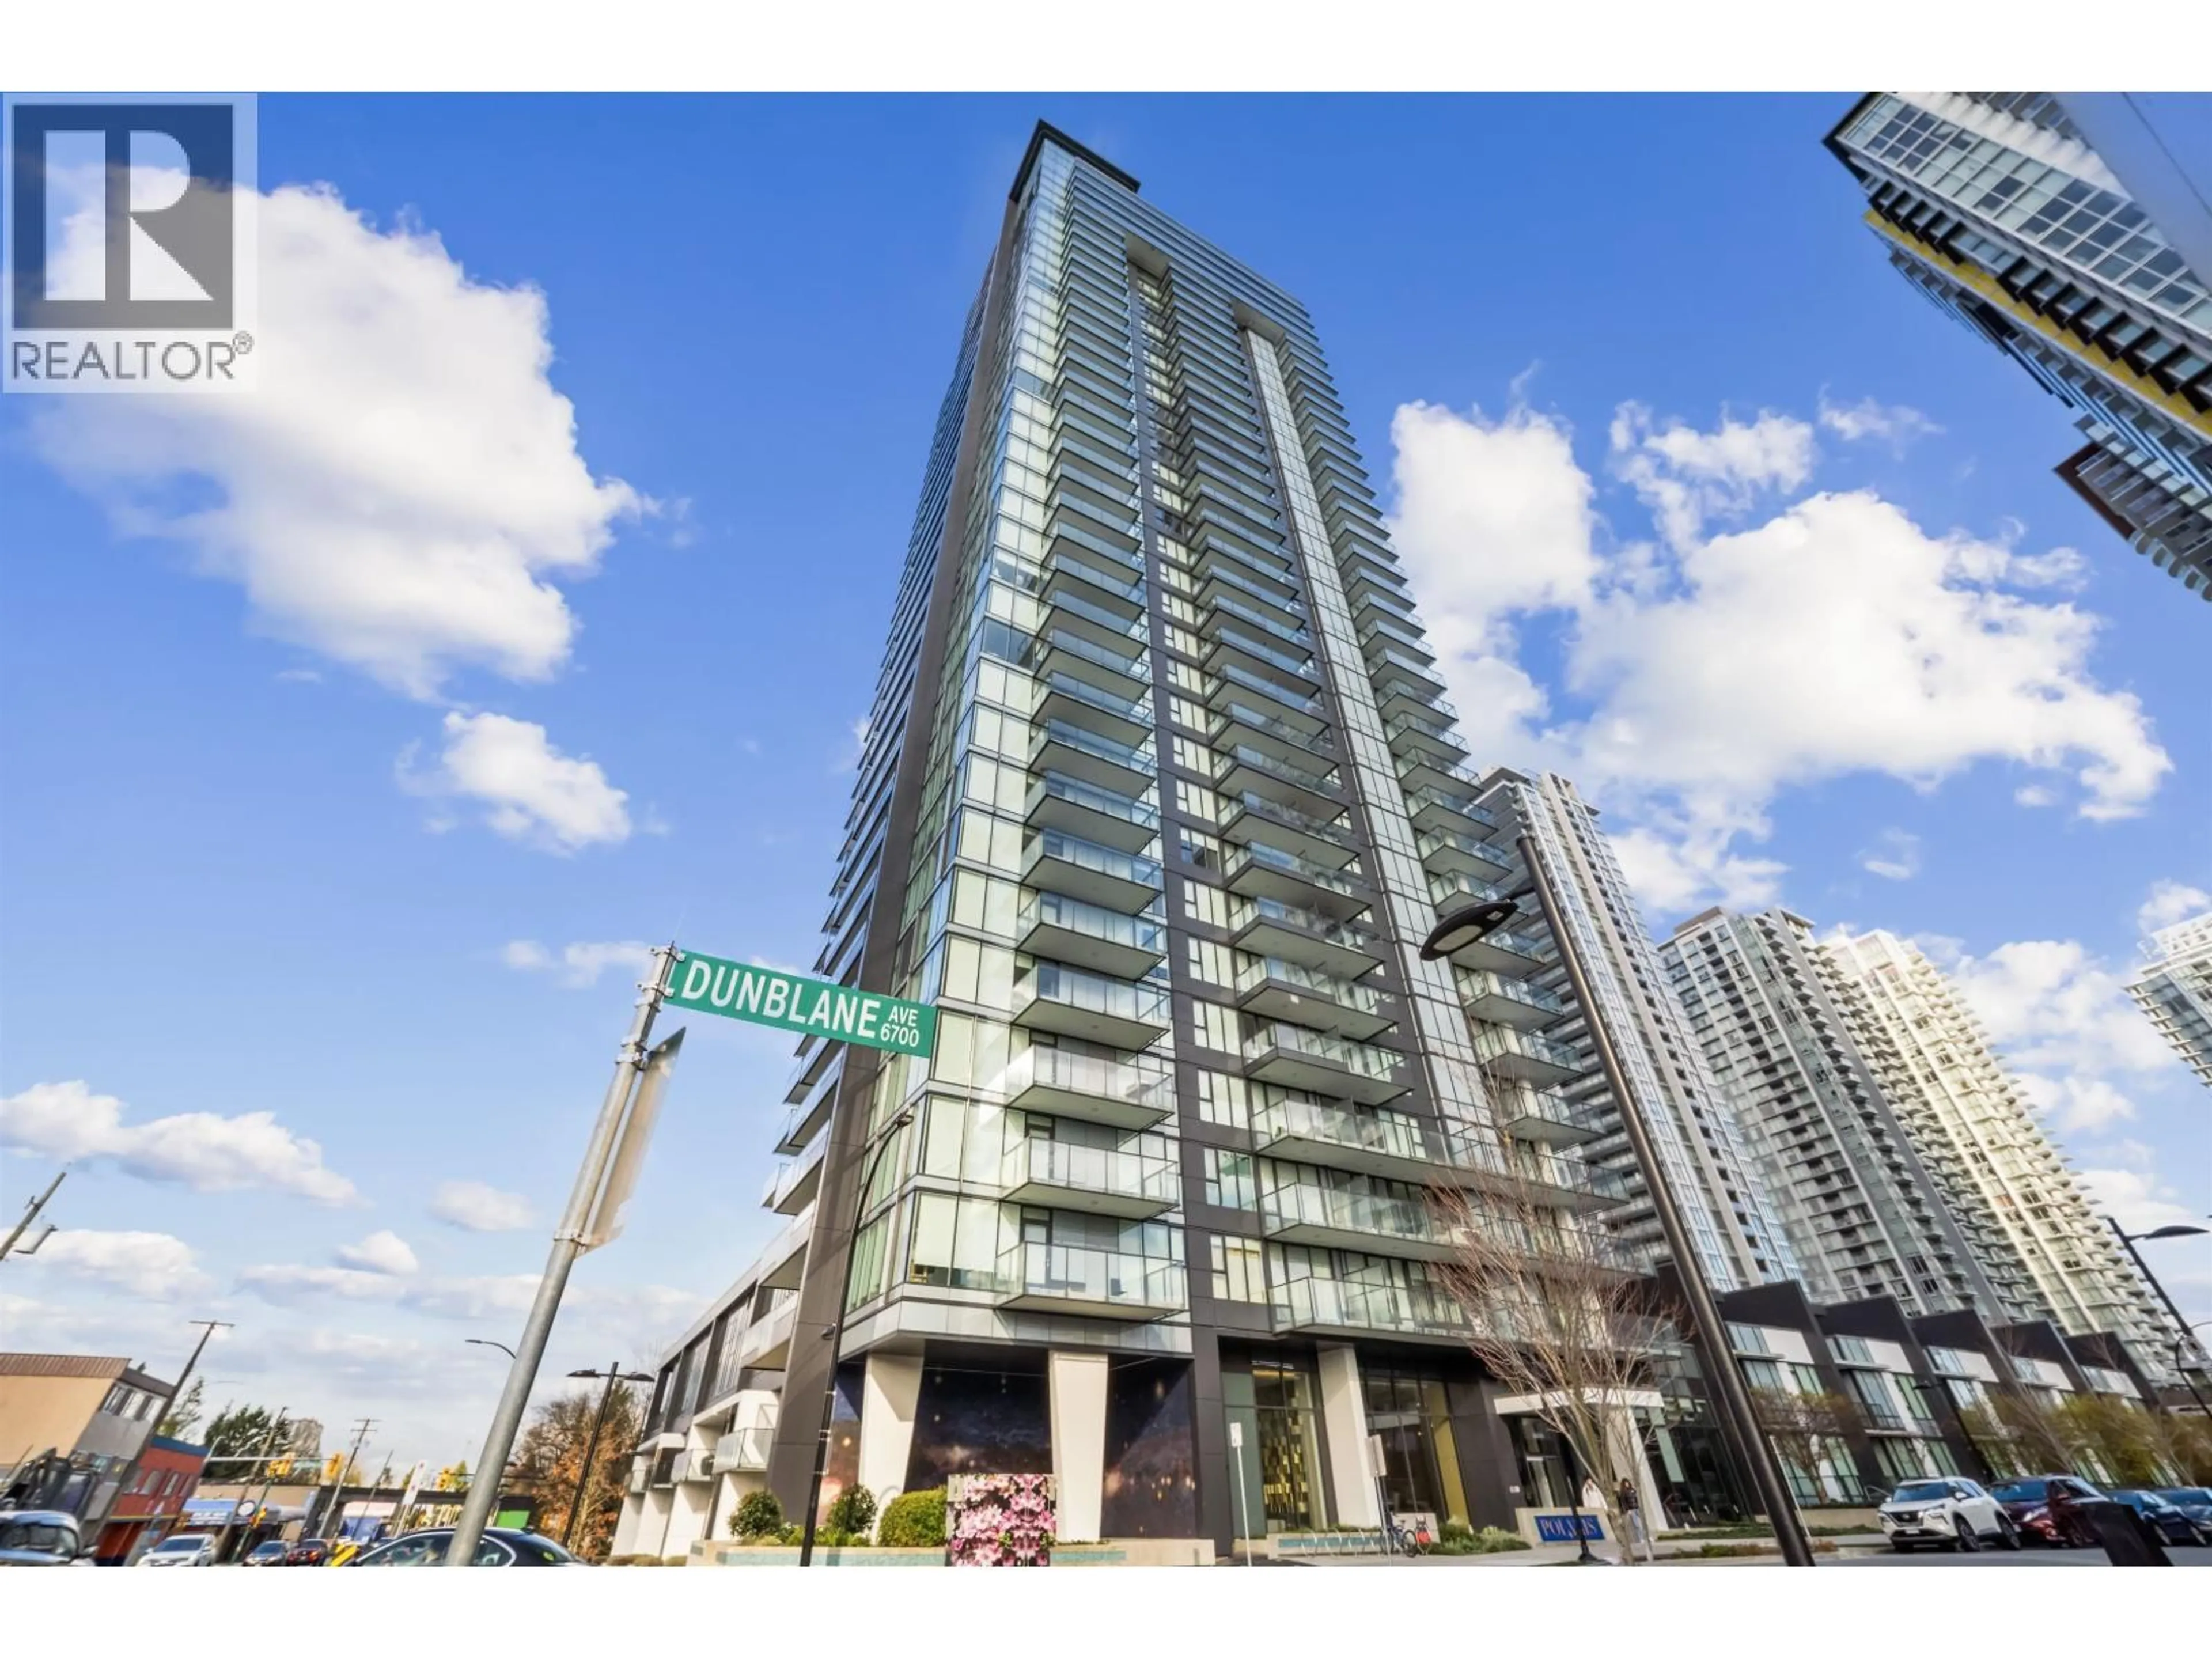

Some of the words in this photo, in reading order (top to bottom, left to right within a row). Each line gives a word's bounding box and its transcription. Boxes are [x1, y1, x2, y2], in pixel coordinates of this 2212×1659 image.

[681, 959, 881, 1039] DUNBLANE
[888, 1005, 919, 1027] AVE
[880, 1022, 920, 1047] 6700
